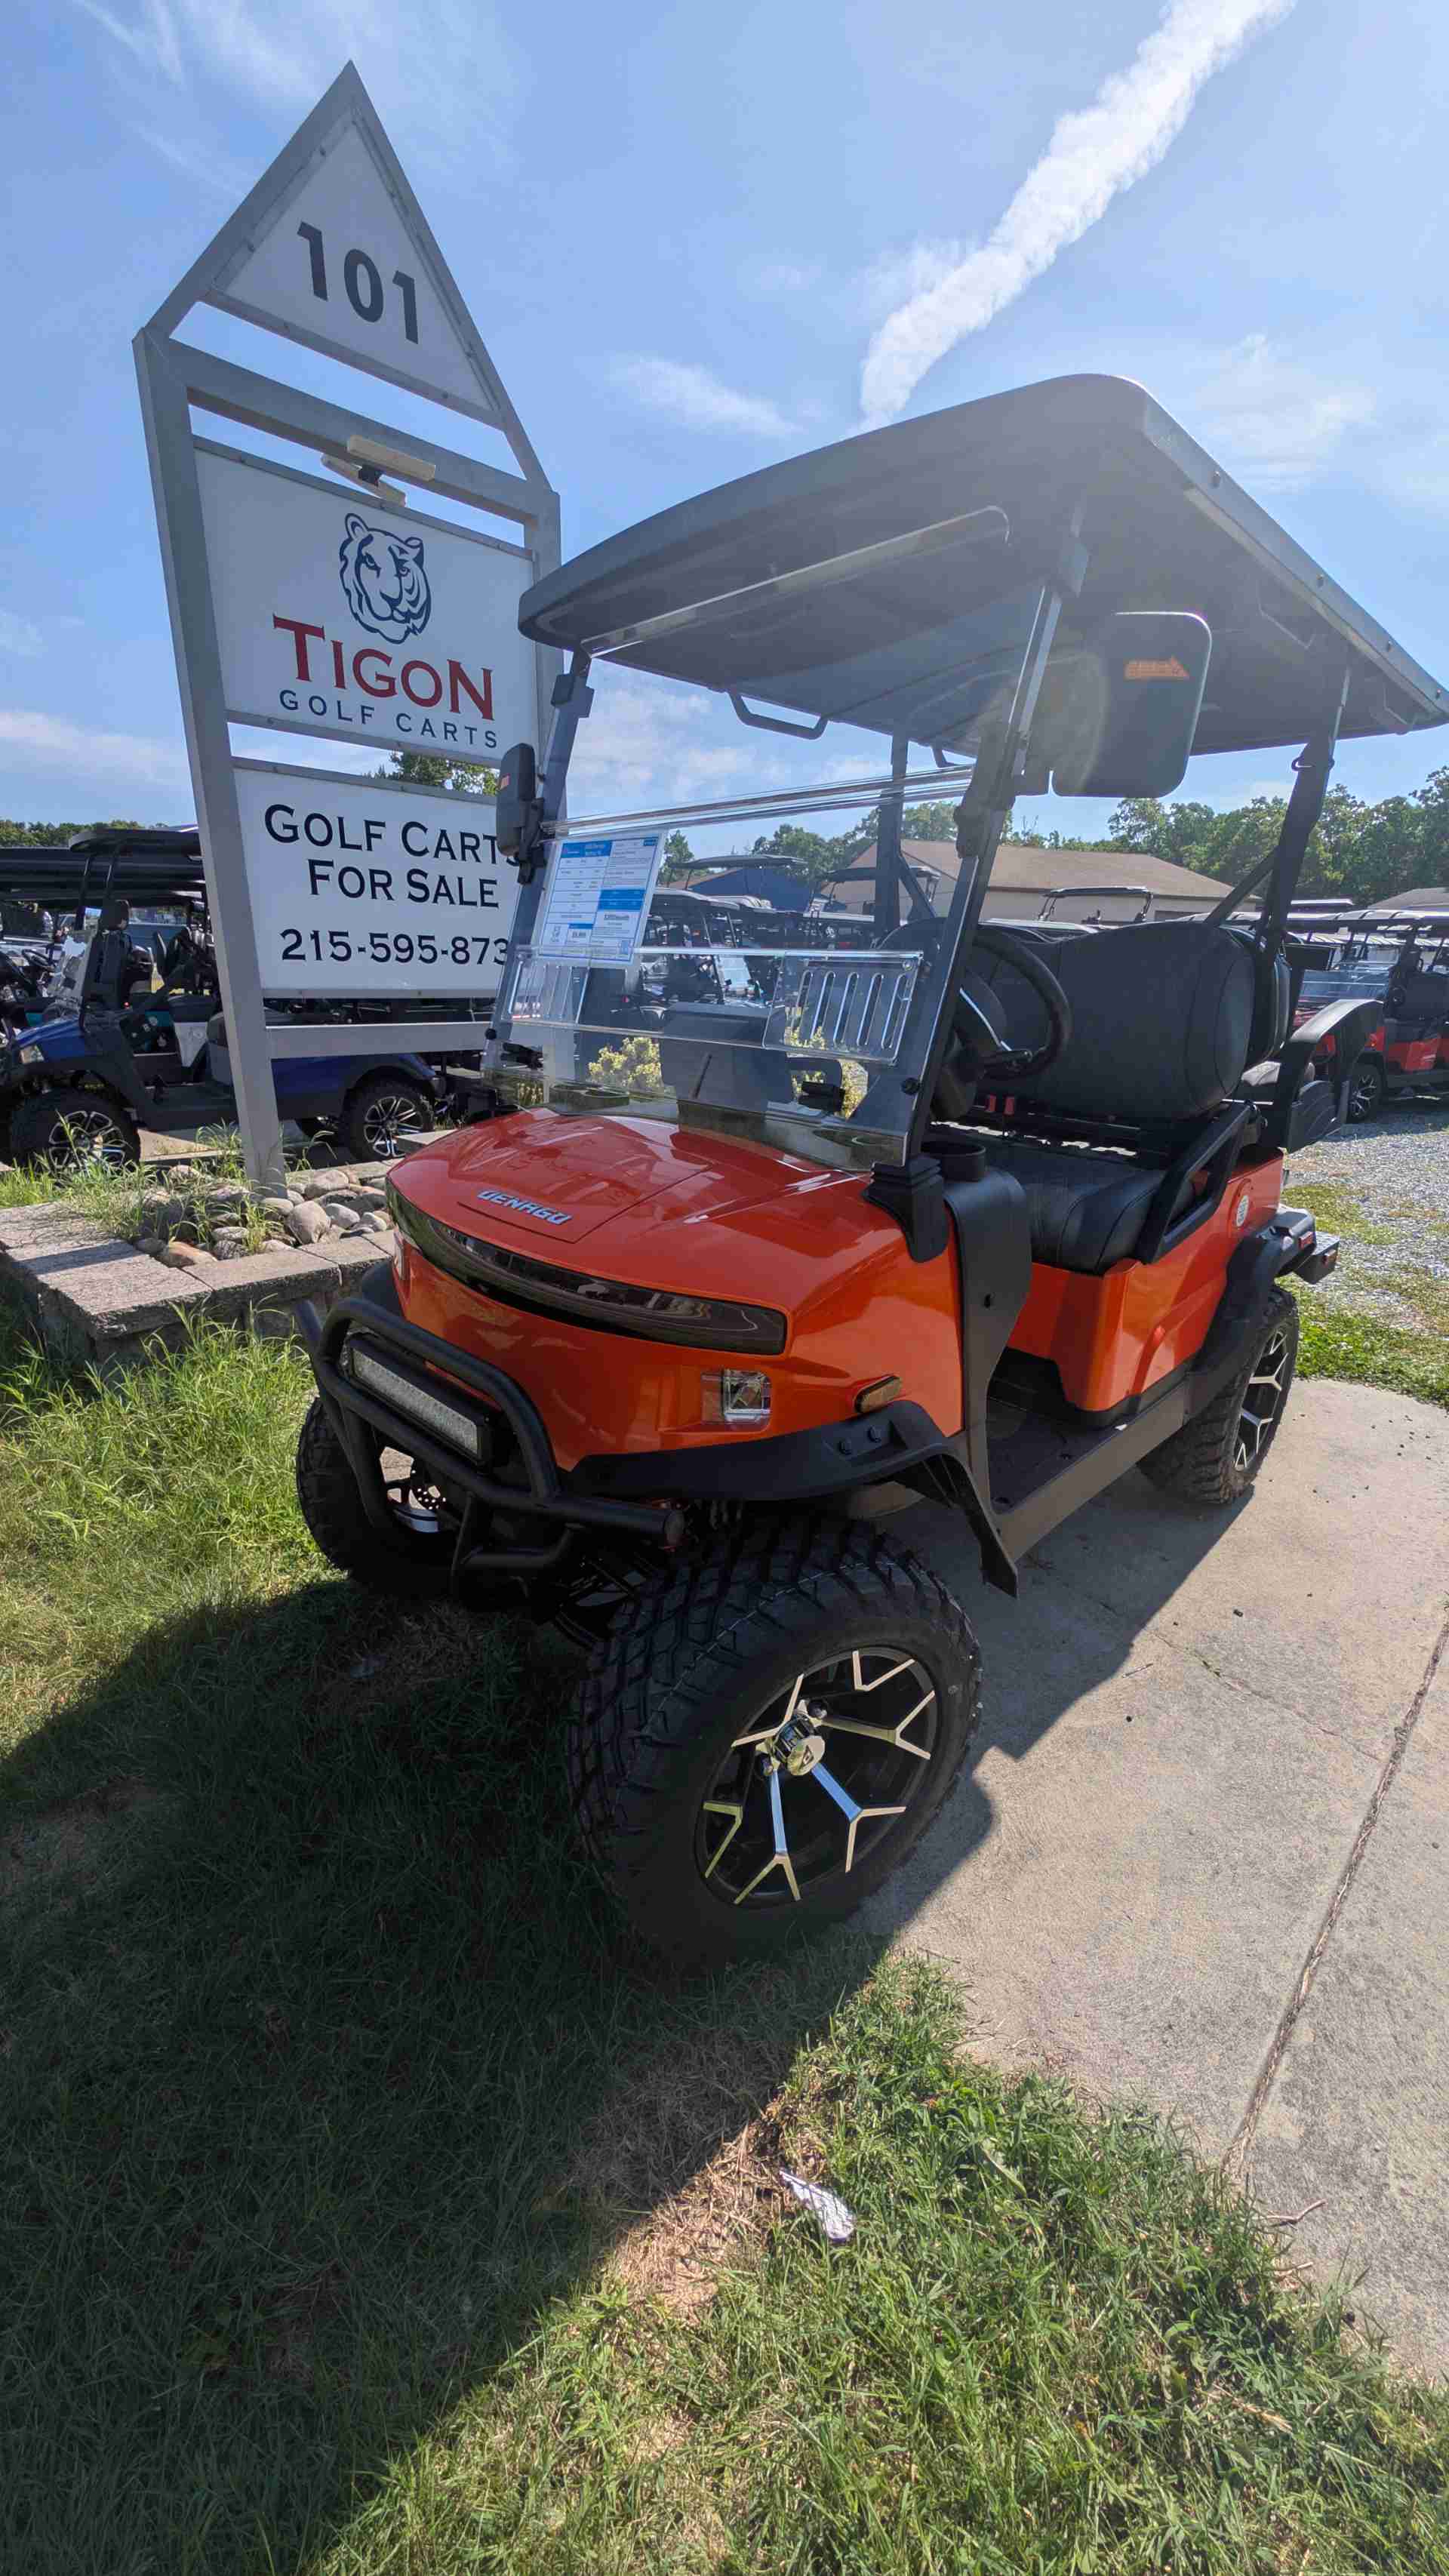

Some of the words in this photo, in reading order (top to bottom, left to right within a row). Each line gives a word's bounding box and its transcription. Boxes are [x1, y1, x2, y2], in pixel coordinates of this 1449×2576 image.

[297, 221, 419, 344] 101
[272, 614, 494, 720] TIGON
[279, 690, 374, 724] GOLF
[395, 713, 497, 748] CARTS
[265, 804, 386, 851] GOLF
[401, 821, 520, 867] CART
[307, 859, 395, 900] FOR
[406, 869, 500, 908] SALE
[279, 928, 509, 965] 215-595-873
